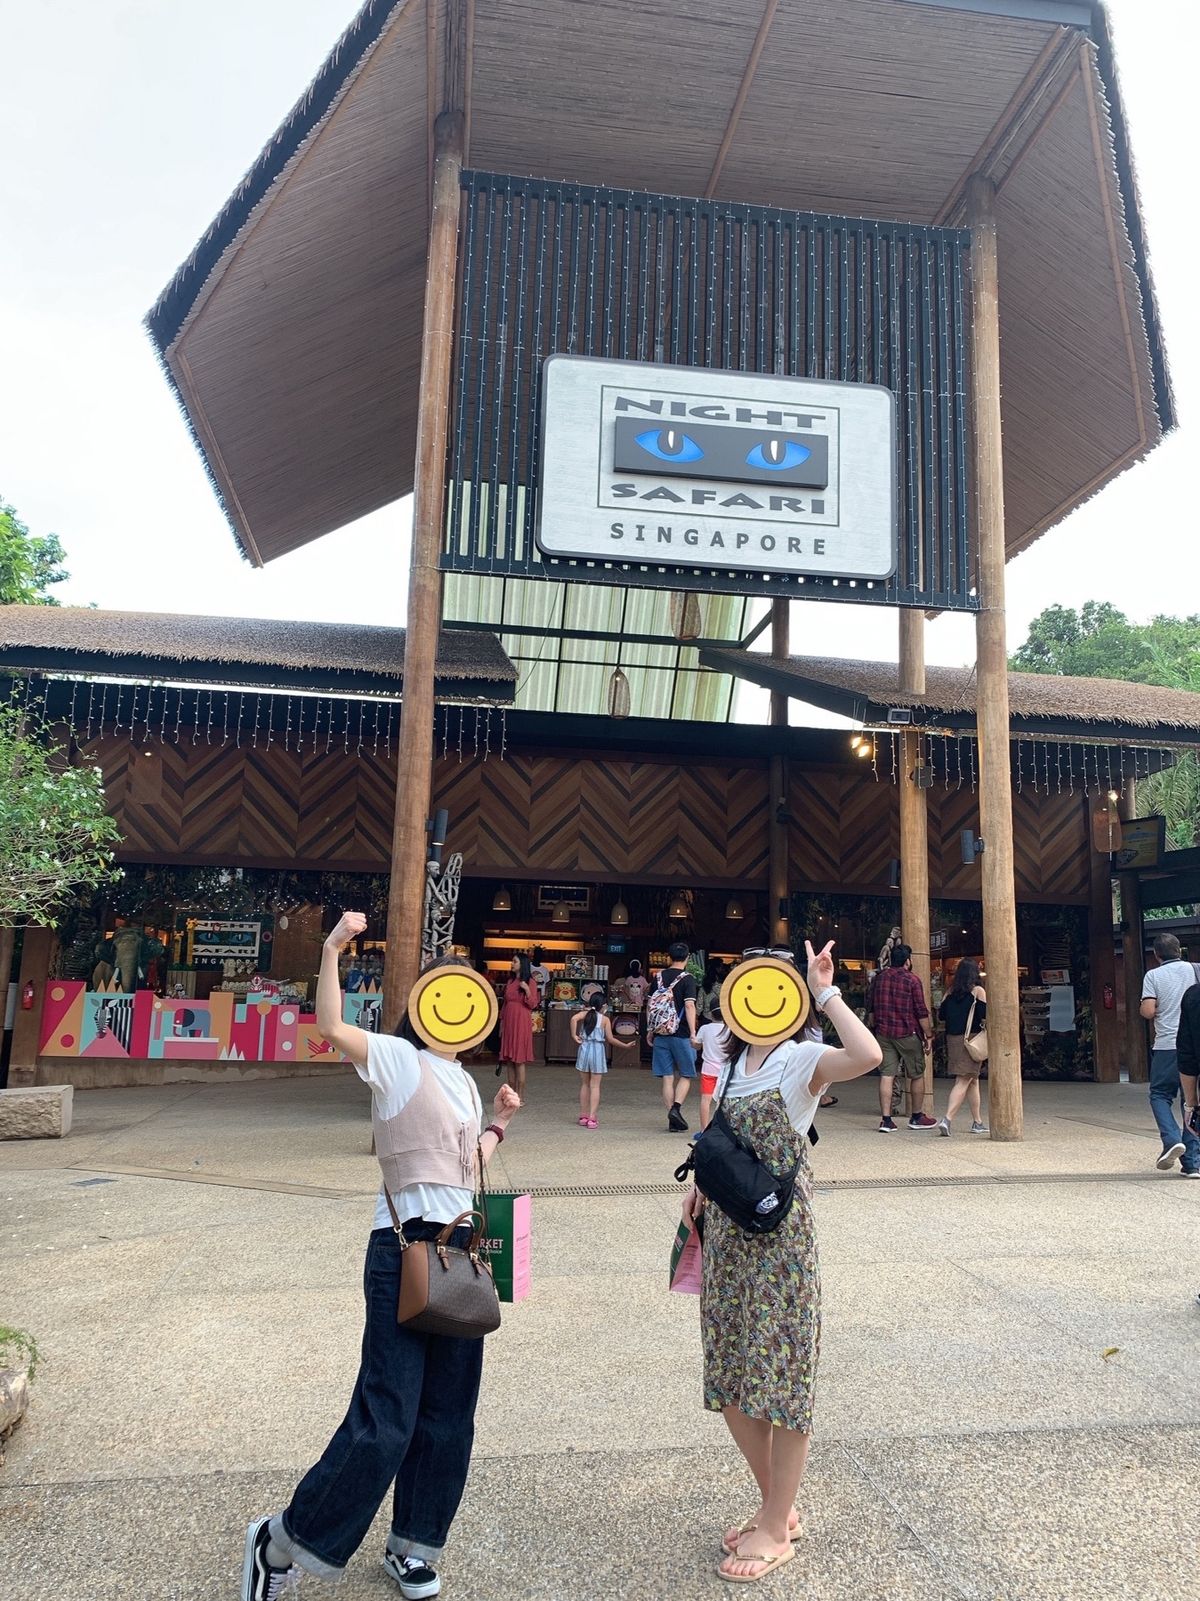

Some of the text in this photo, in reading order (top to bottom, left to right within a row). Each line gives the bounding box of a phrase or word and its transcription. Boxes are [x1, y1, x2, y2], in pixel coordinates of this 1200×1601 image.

[614, 396, 826, 428] NIGHT
[610, 484, 825, 514] SAFARI
[610, 523, 825, 555] SINGAPORE
[479, 1238, 504, 1249] RKET
